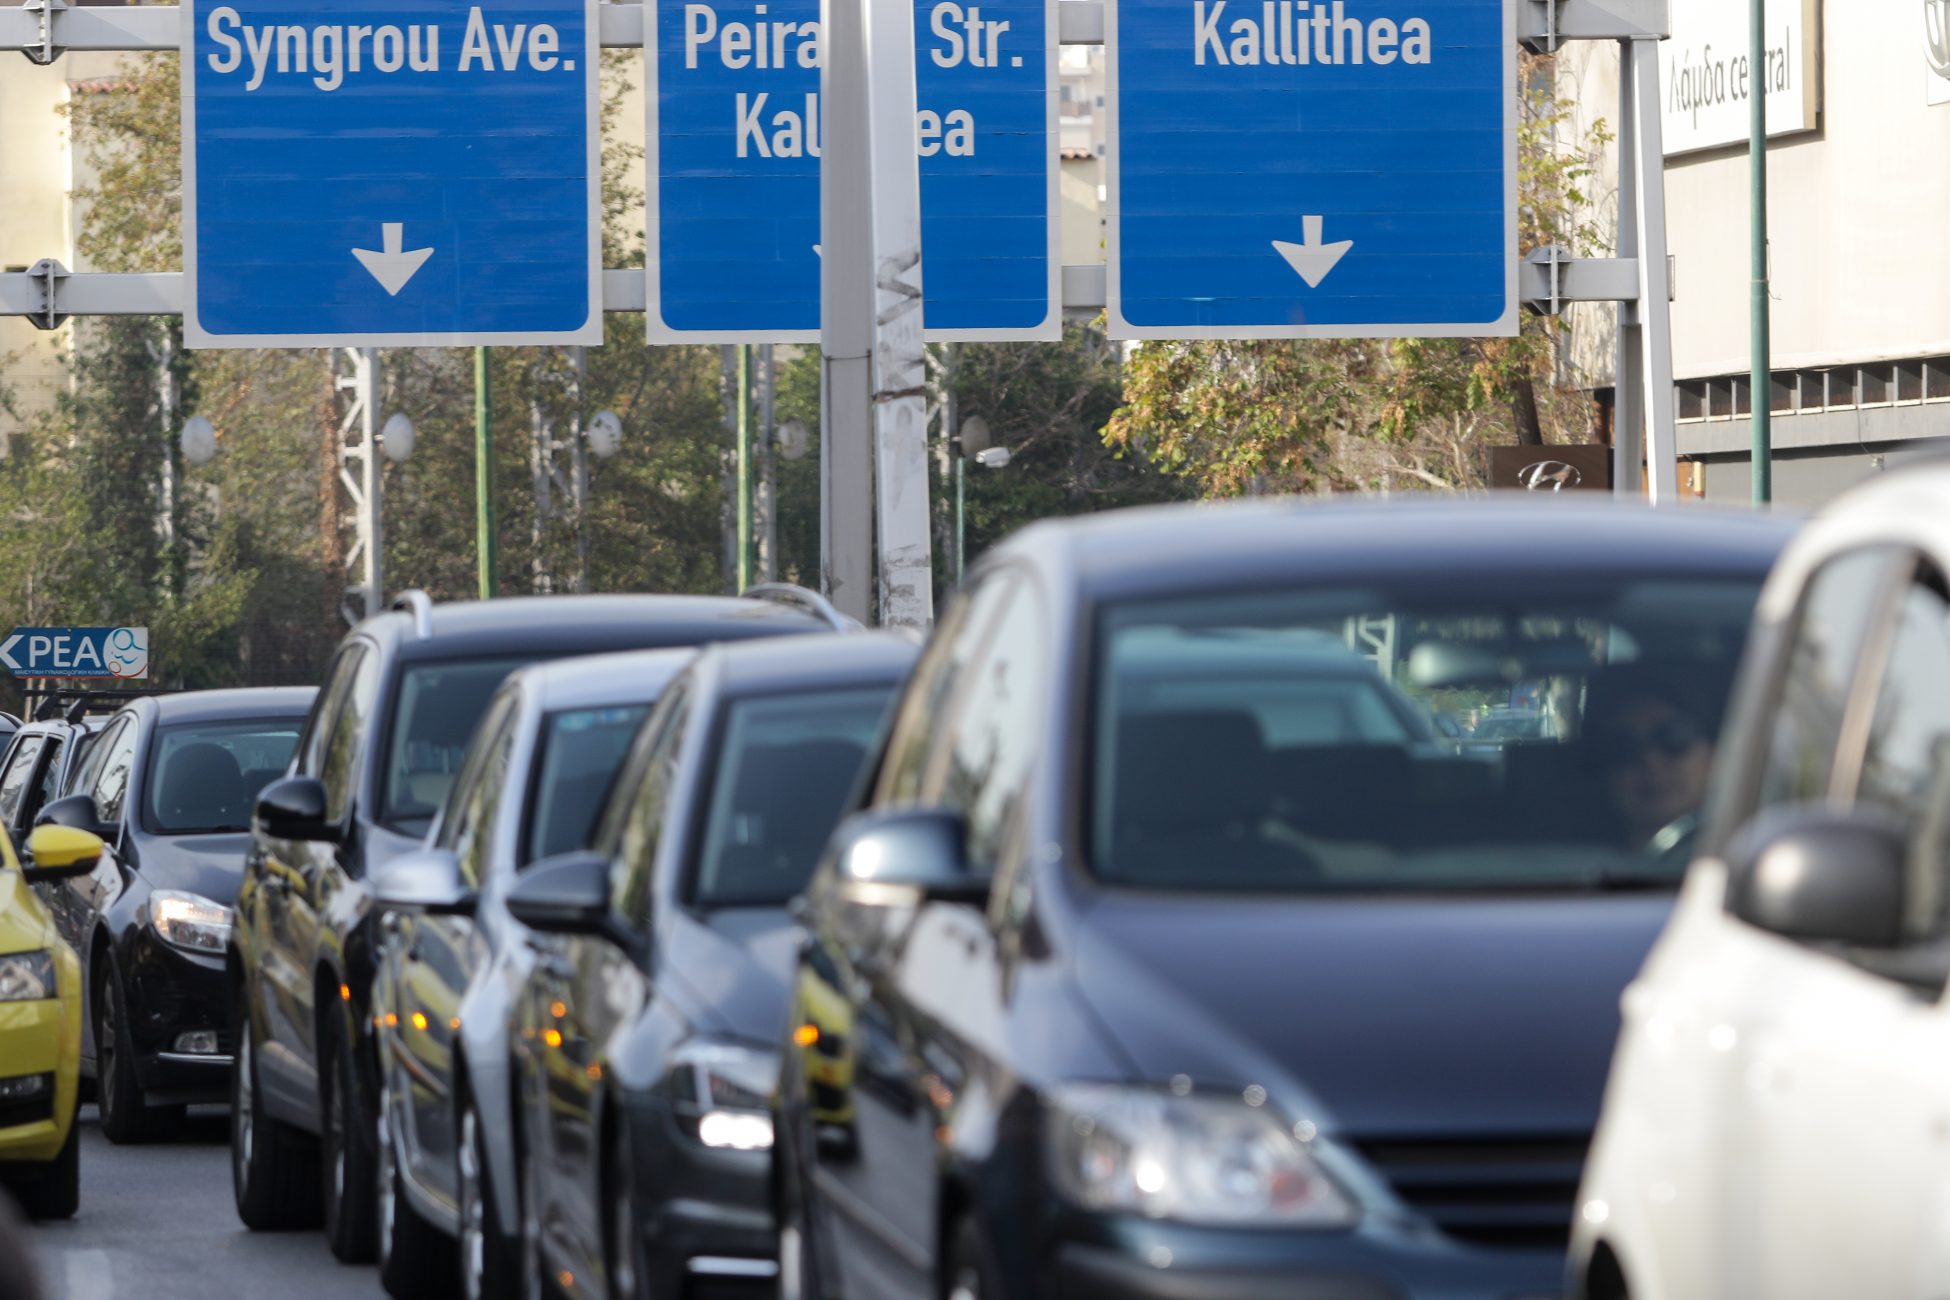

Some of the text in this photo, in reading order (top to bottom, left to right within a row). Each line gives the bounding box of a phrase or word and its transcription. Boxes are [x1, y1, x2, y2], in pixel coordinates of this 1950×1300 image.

[207, 6, 576, 91] Syngrou Ave.
[930, 2, 1024, 68] Str.
[1193, 0, 1431, 66] Kallithea
[1669, 25, 1791, 131] Λάμδα ceral
[736, 92, 975, 158] Kalea
